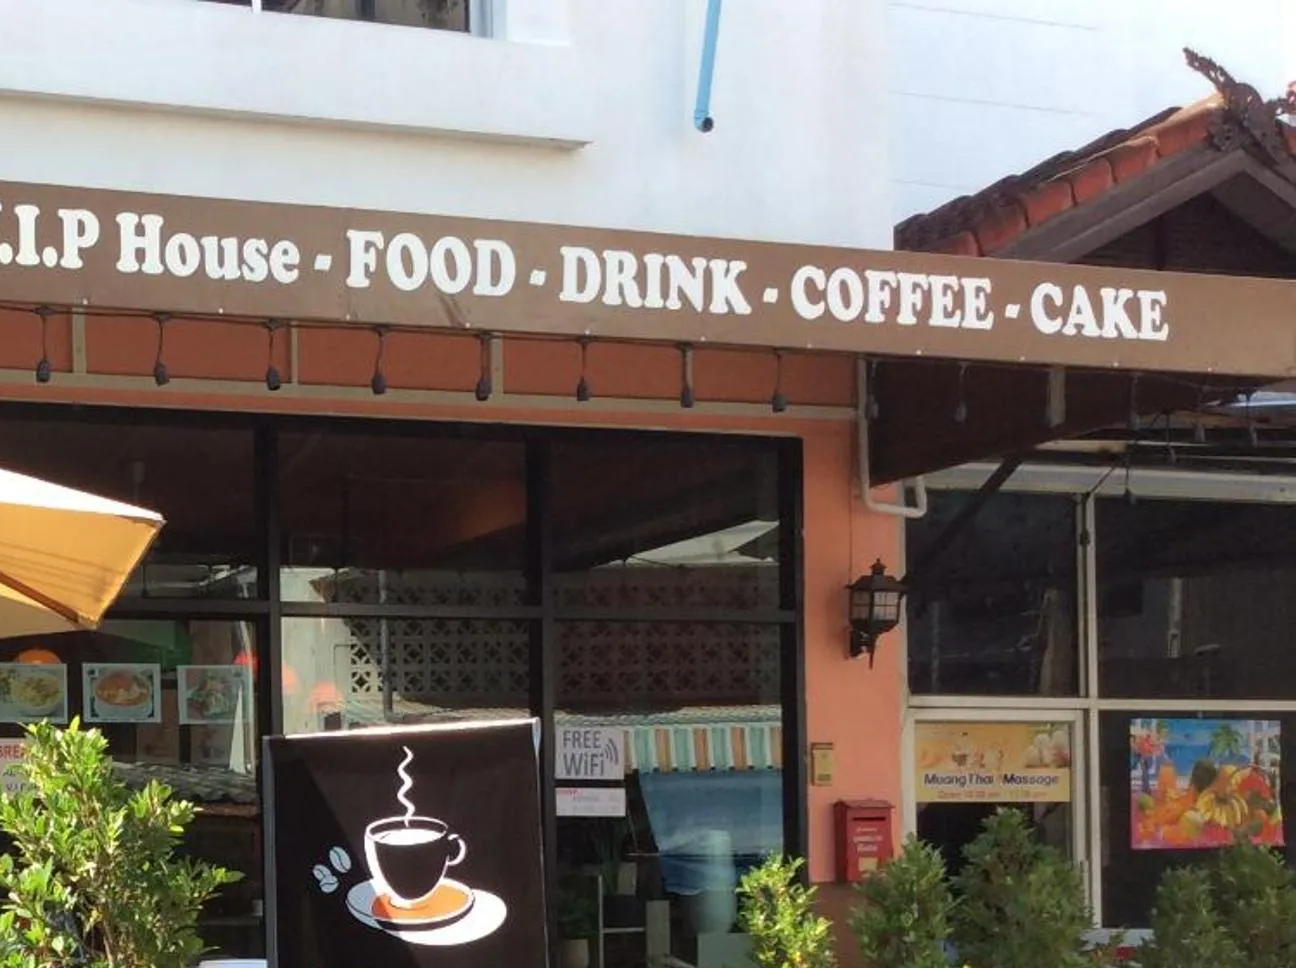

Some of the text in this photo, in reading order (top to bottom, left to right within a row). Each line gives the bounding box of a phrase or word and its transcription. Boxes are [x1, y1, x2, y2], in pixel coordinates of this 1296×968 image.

[115, 212, 300, 284] House
[346, 229, 516, 296] FOOD
[559, 246, 752, 315] DRINK
[791, 265, 994, 330] COFFEE
[1030, 282, 1169, 341] CAKE
[563, 730, 602, 750] FREE
